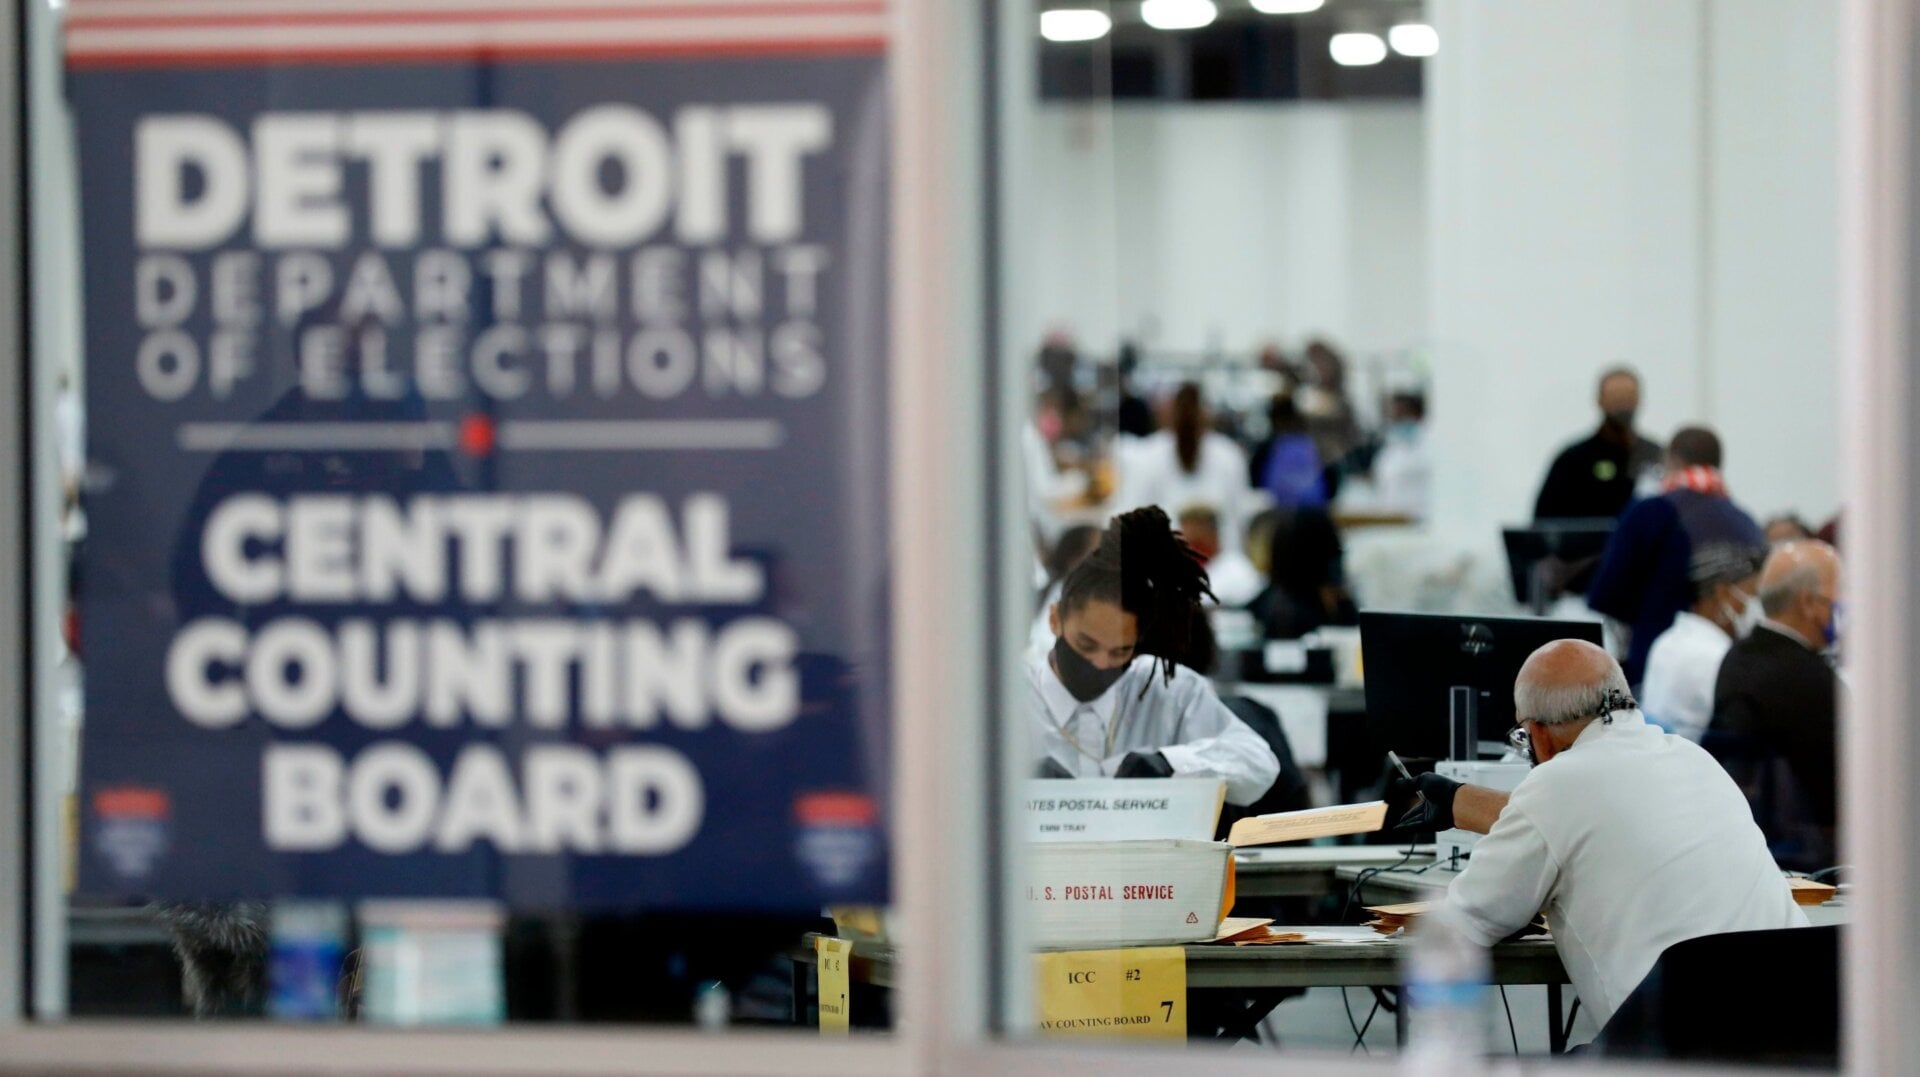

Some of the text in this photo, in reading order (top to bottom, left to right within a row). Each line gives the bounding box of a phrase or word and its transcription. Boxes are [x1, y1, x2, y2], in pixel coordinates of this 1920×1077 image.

[133, 105, 831, 247] DETROIT
[136, 247, 829, 327] DEPARTMENT
[137, 326, 826, 400] OF ELECTIONS
[203, 493, 763, 603] CENTRAL
[167, 619, 799, 731] COUNTING
[263, 743, 703, 855] BOARD
[1058, 799, 1109, 811] POSTAL
[1112, 798, 1170, 810] SERVICE
[1063, 824, 1086, 832] TRAY
[1045, 886, 1056, 900] S.
[1065, 886, 1114, 900] POSTAL
[1123, 885, 1174, 900] SERVICE
[1068, 969, 1141, 985] ICC #2
[1056, 1016, 1112, 1029] COUNTING
[1114, 1014, 1151, 1026] BOARD
[1160, 1000, 1174, 1024] 7
